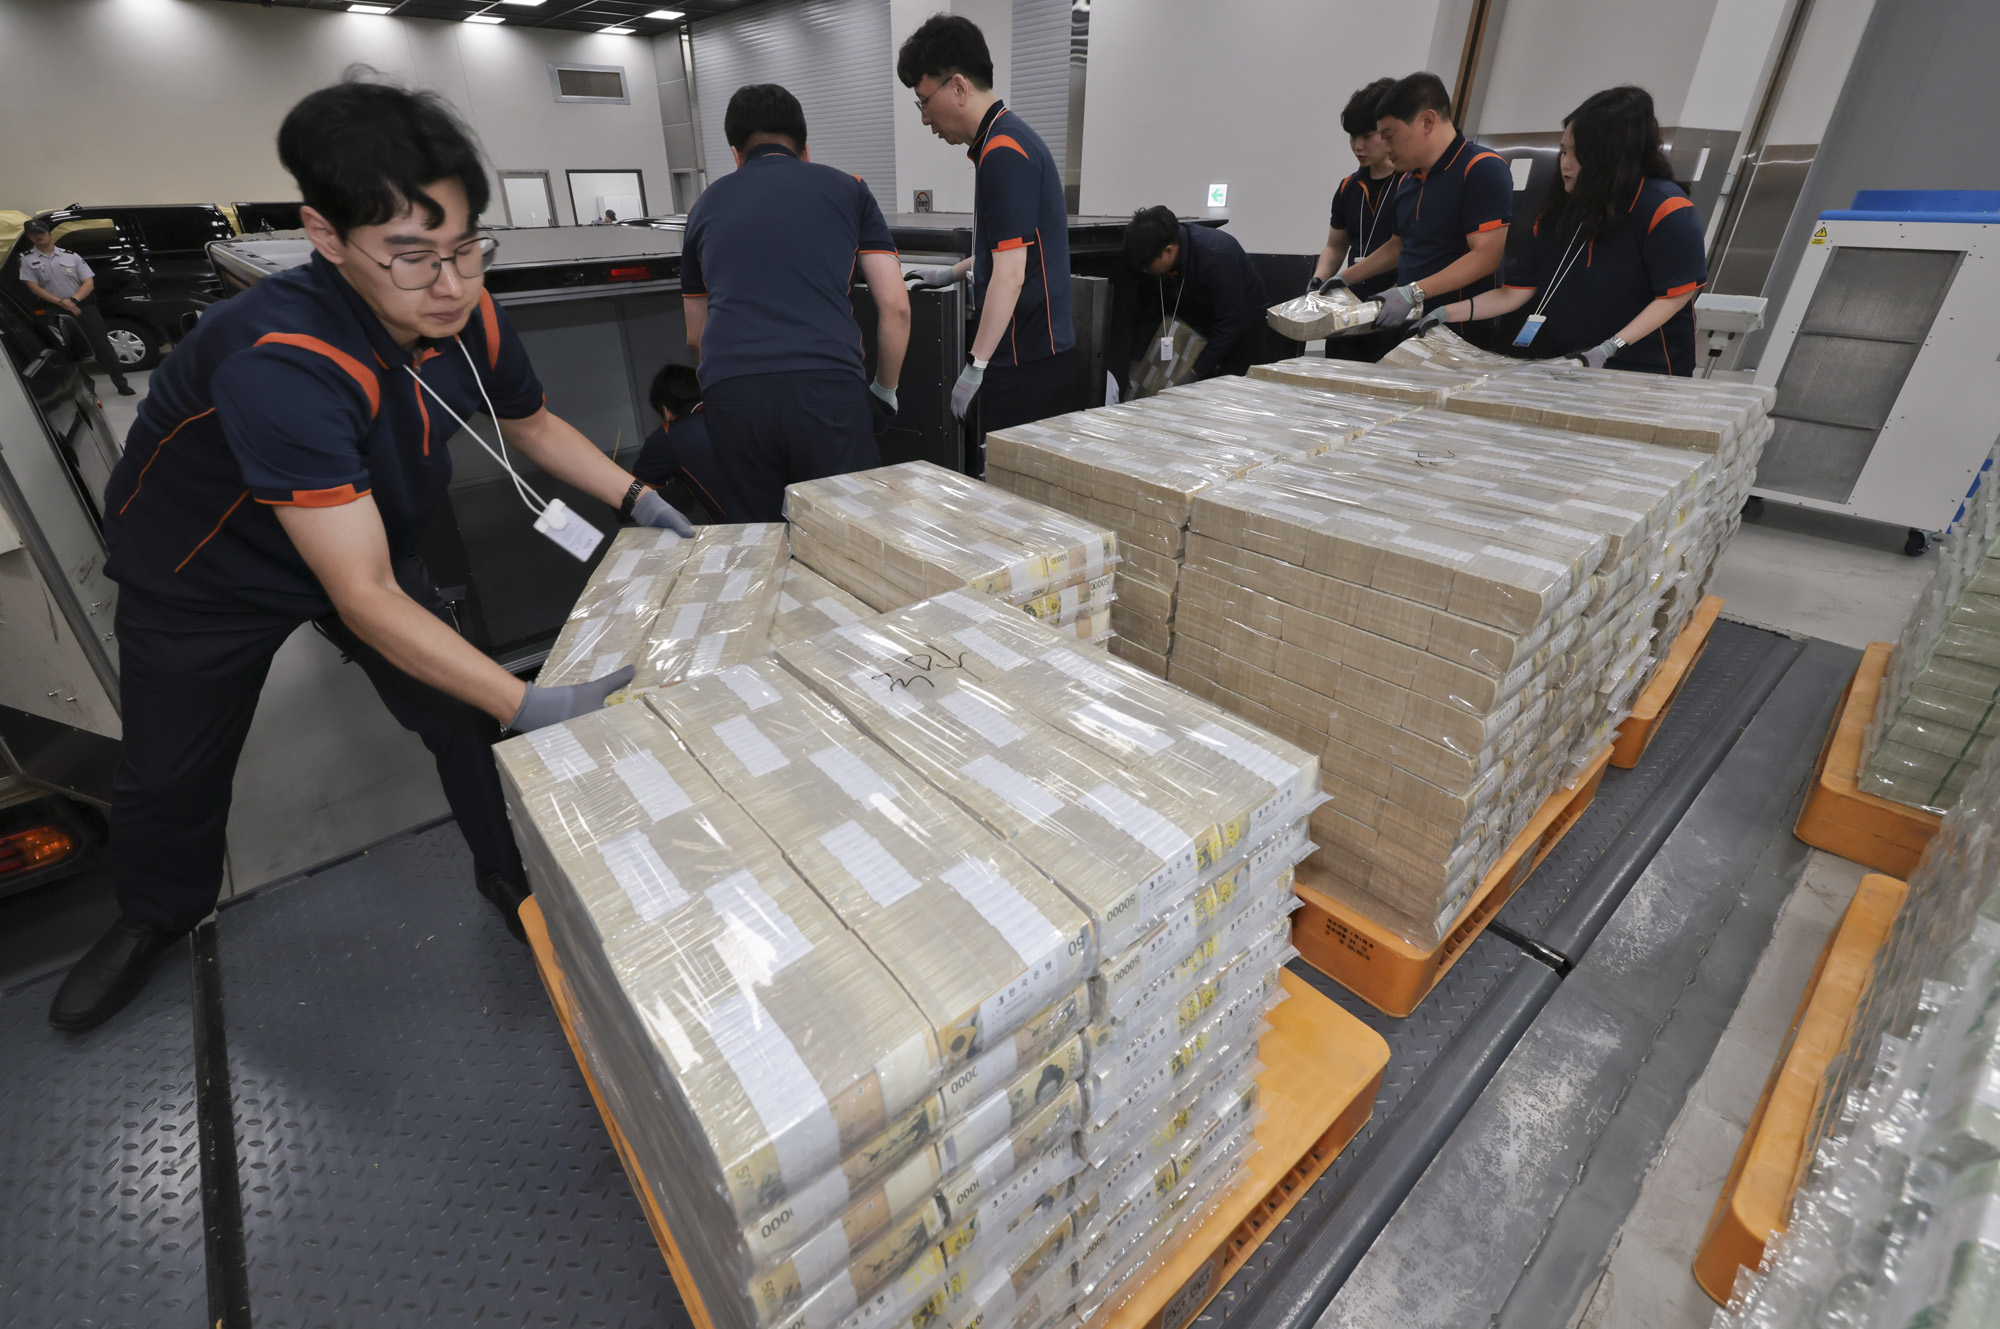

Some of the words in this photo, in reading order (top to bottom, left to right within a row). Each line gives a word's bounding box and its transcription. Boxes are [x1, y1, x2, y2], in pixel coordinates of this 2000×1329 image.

[1157, 853, 1191, 884] 한국은행
[1106, 893, 1136, 922] 50000
[1158, 914, 1189, 945] 한국은행
[1068, 934, 1085, 956] 50
[1009, 961, 1052, 998] 한국은행
[1113, 955, 1140, 983] 50000
